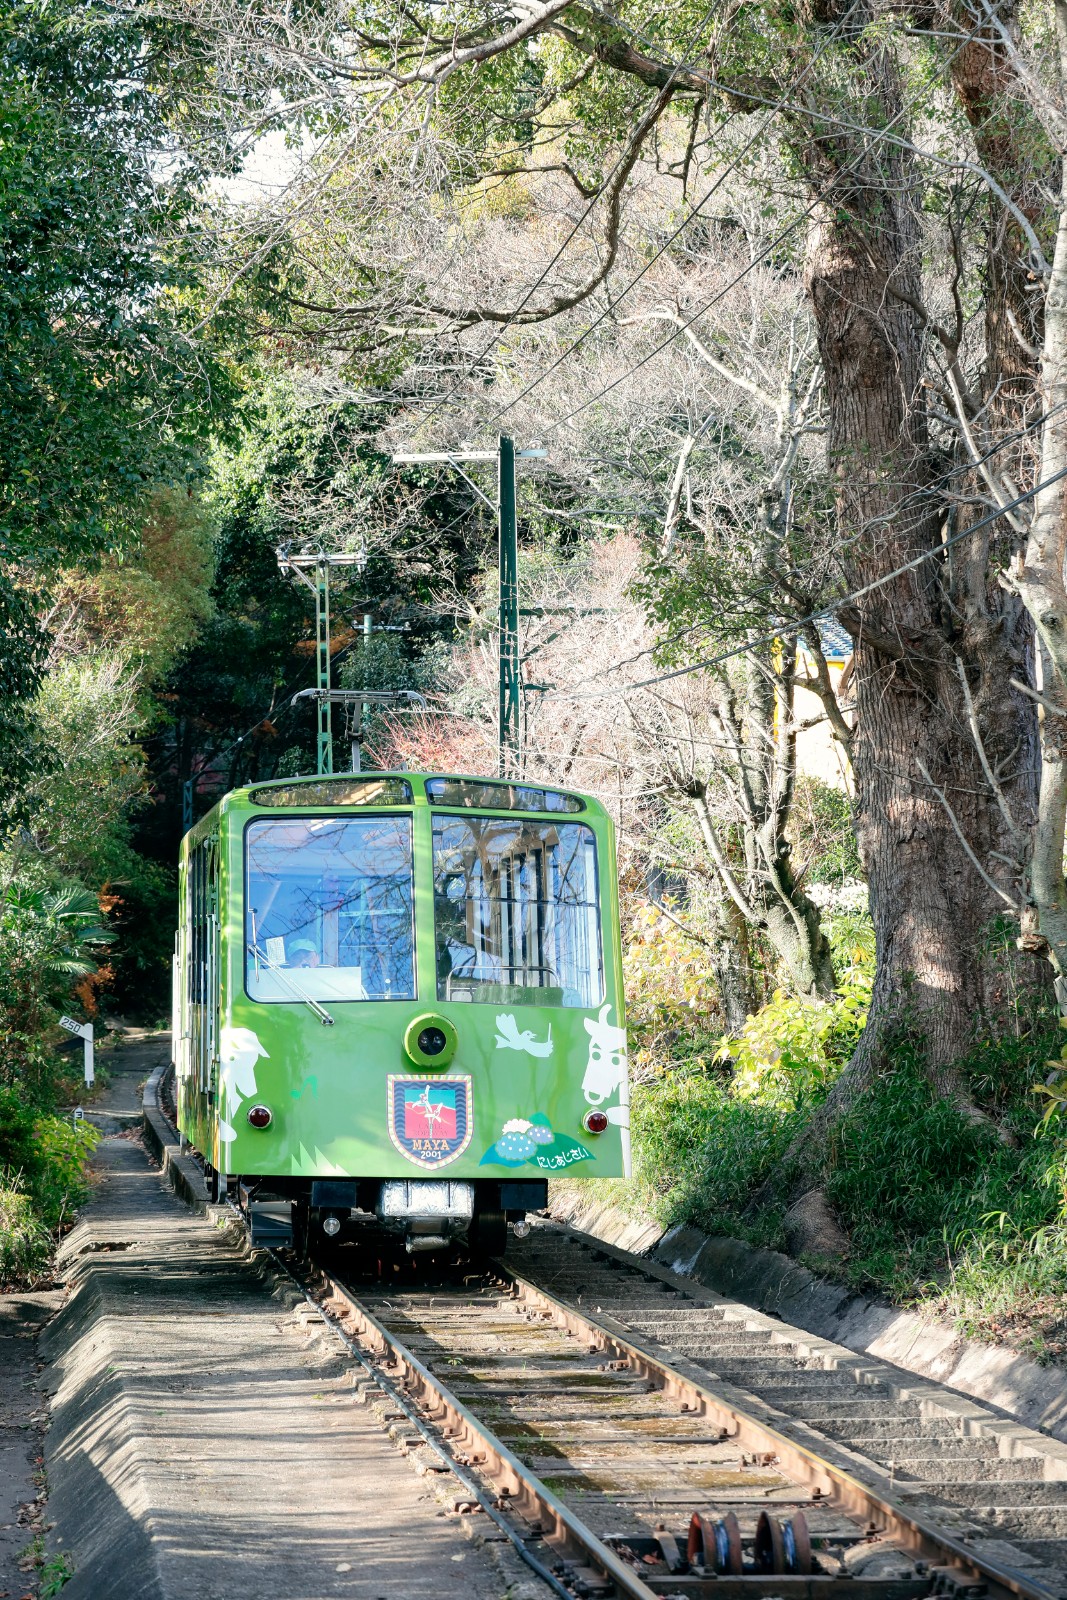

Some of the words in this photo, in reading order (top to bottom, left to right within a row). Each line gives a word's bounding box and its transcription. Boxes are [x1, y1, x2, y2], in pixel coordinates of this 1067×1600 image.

[61, 1018, 81, 1032] 250
[412, 1140, 449, 1151] MAYA
[420, 1150, 442, 1160] 2001
[536, 1146, 589, 1169] にじあじさい
